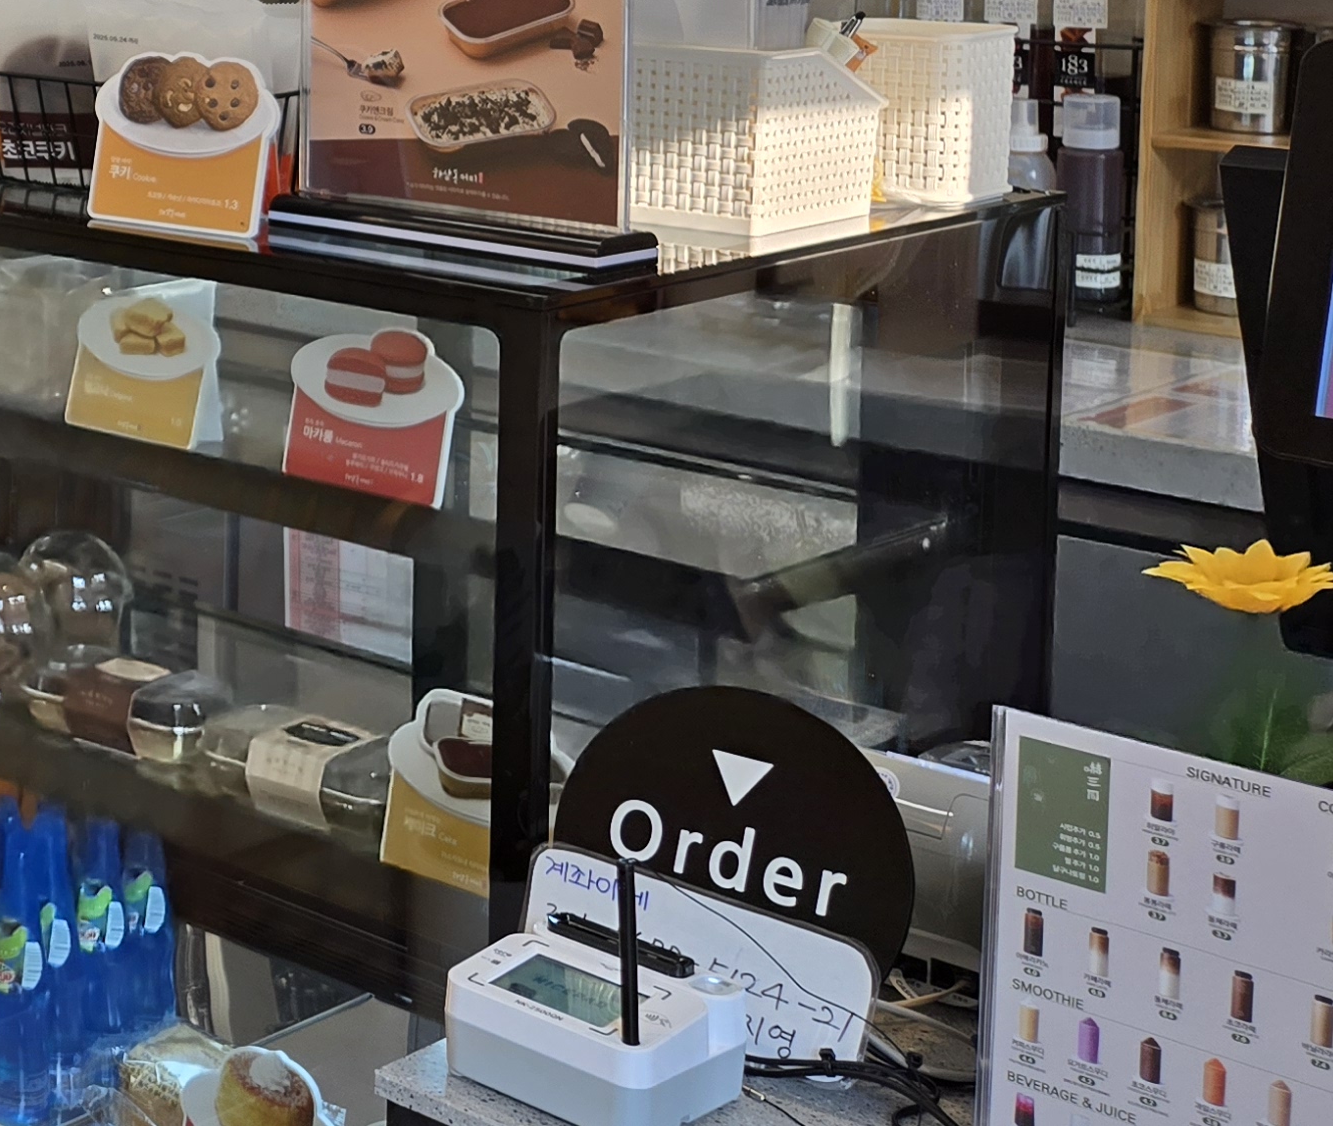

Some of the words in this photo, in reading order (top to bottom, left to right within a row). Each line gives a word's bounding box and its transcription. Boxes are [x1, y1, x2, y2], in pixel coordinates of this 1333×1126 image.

[109, 164, 131, 180] 쿠키
[303, 426, 333, 444] 마카롱
[1186, 766, 1272, 798] SIGNATURE
[610, 798, 847, 917] Order
[1016, 885, 1068, 910] BOTTLE
[1012, 978, 1084, 1010] SMOOTHIE
[1007, 1070, 1078, 1105] BEVERAGE
[1082, 1097, 1093, 1110] &
[1096, 1104, 1136, 1124] JUICE
